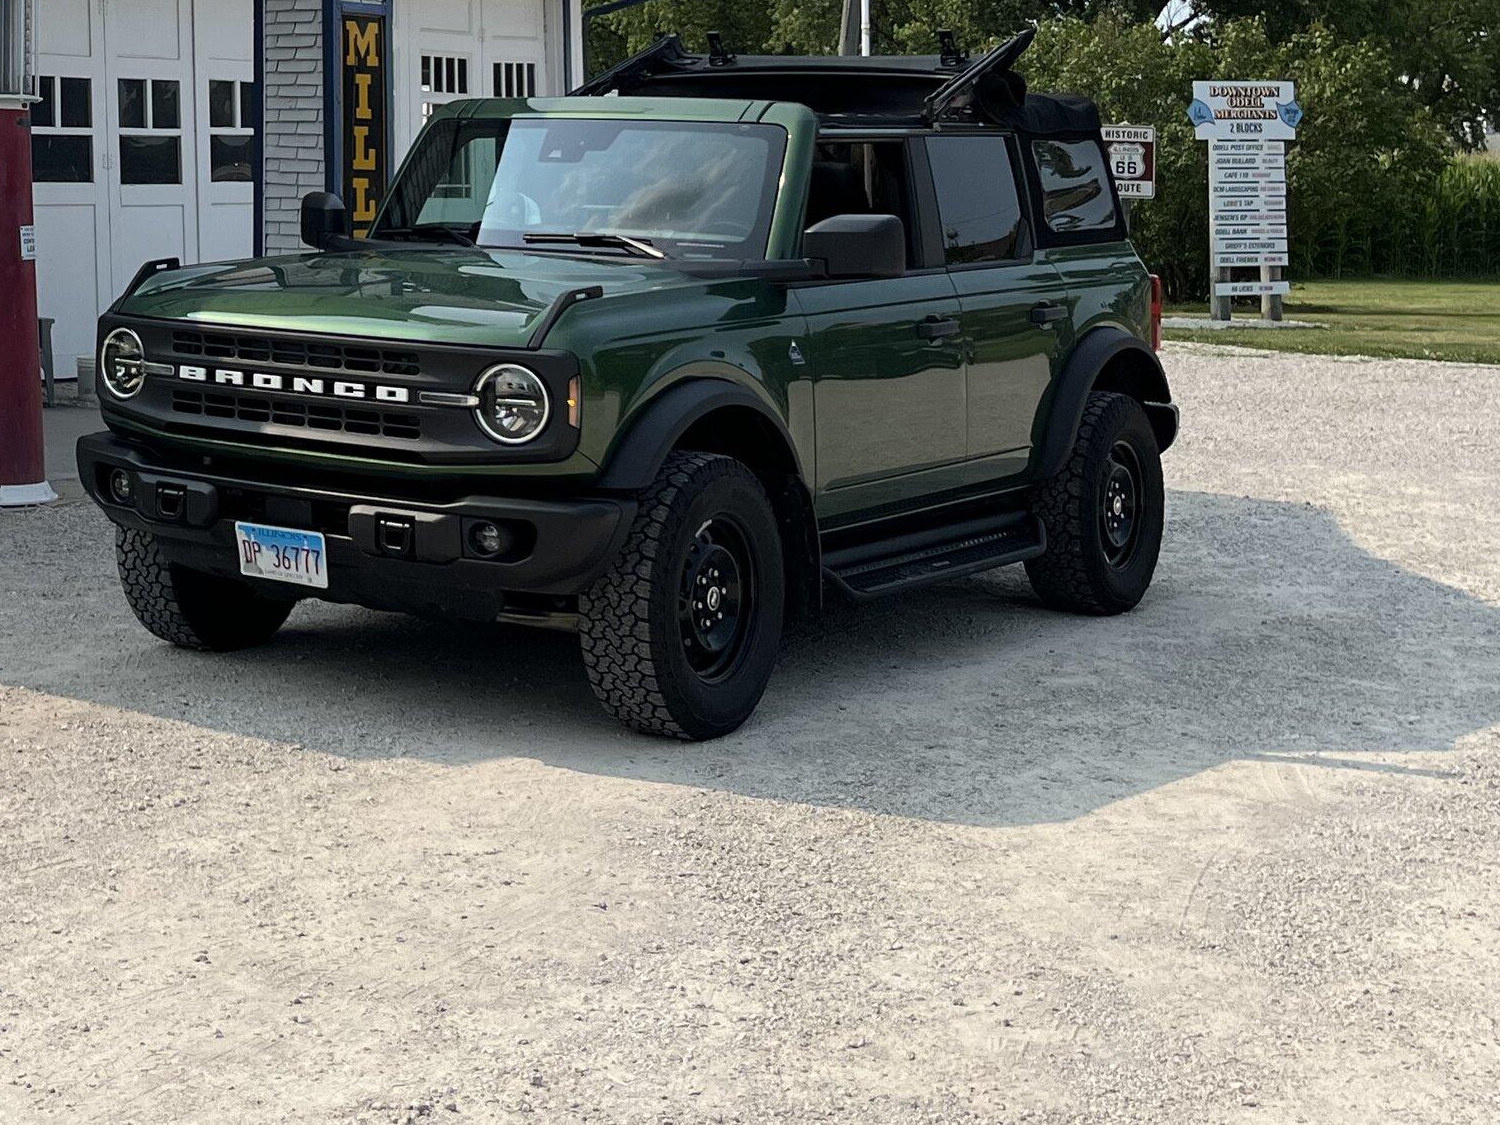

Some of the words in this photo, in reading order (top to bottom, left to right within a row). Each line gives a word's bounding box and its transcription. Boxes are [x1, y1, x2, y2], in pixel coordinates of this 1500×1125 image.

[1209, 86, 1280, 97] DOWNTOWN
[1227, 97, 1264, 108] ODELL
[1214, 109, 1278, 120] MERCHANTS
[346, 20, 378, 239] MILL
[1230, 123, 1236, 134] 2
[1237, 123, 1263, 134] BLOCKS
[1105, 129, 1148, 140] HISTORIC
[1116, 161, 1136, 174] 66
[1117, 183, 1141, 192] OUTE
[179, 365, 409, 402] BRONCO
[258, 528, 300, 540] ILLINOIS
[242, 540, 260, 563] DP
[271, 544, 320, 575] 36777
